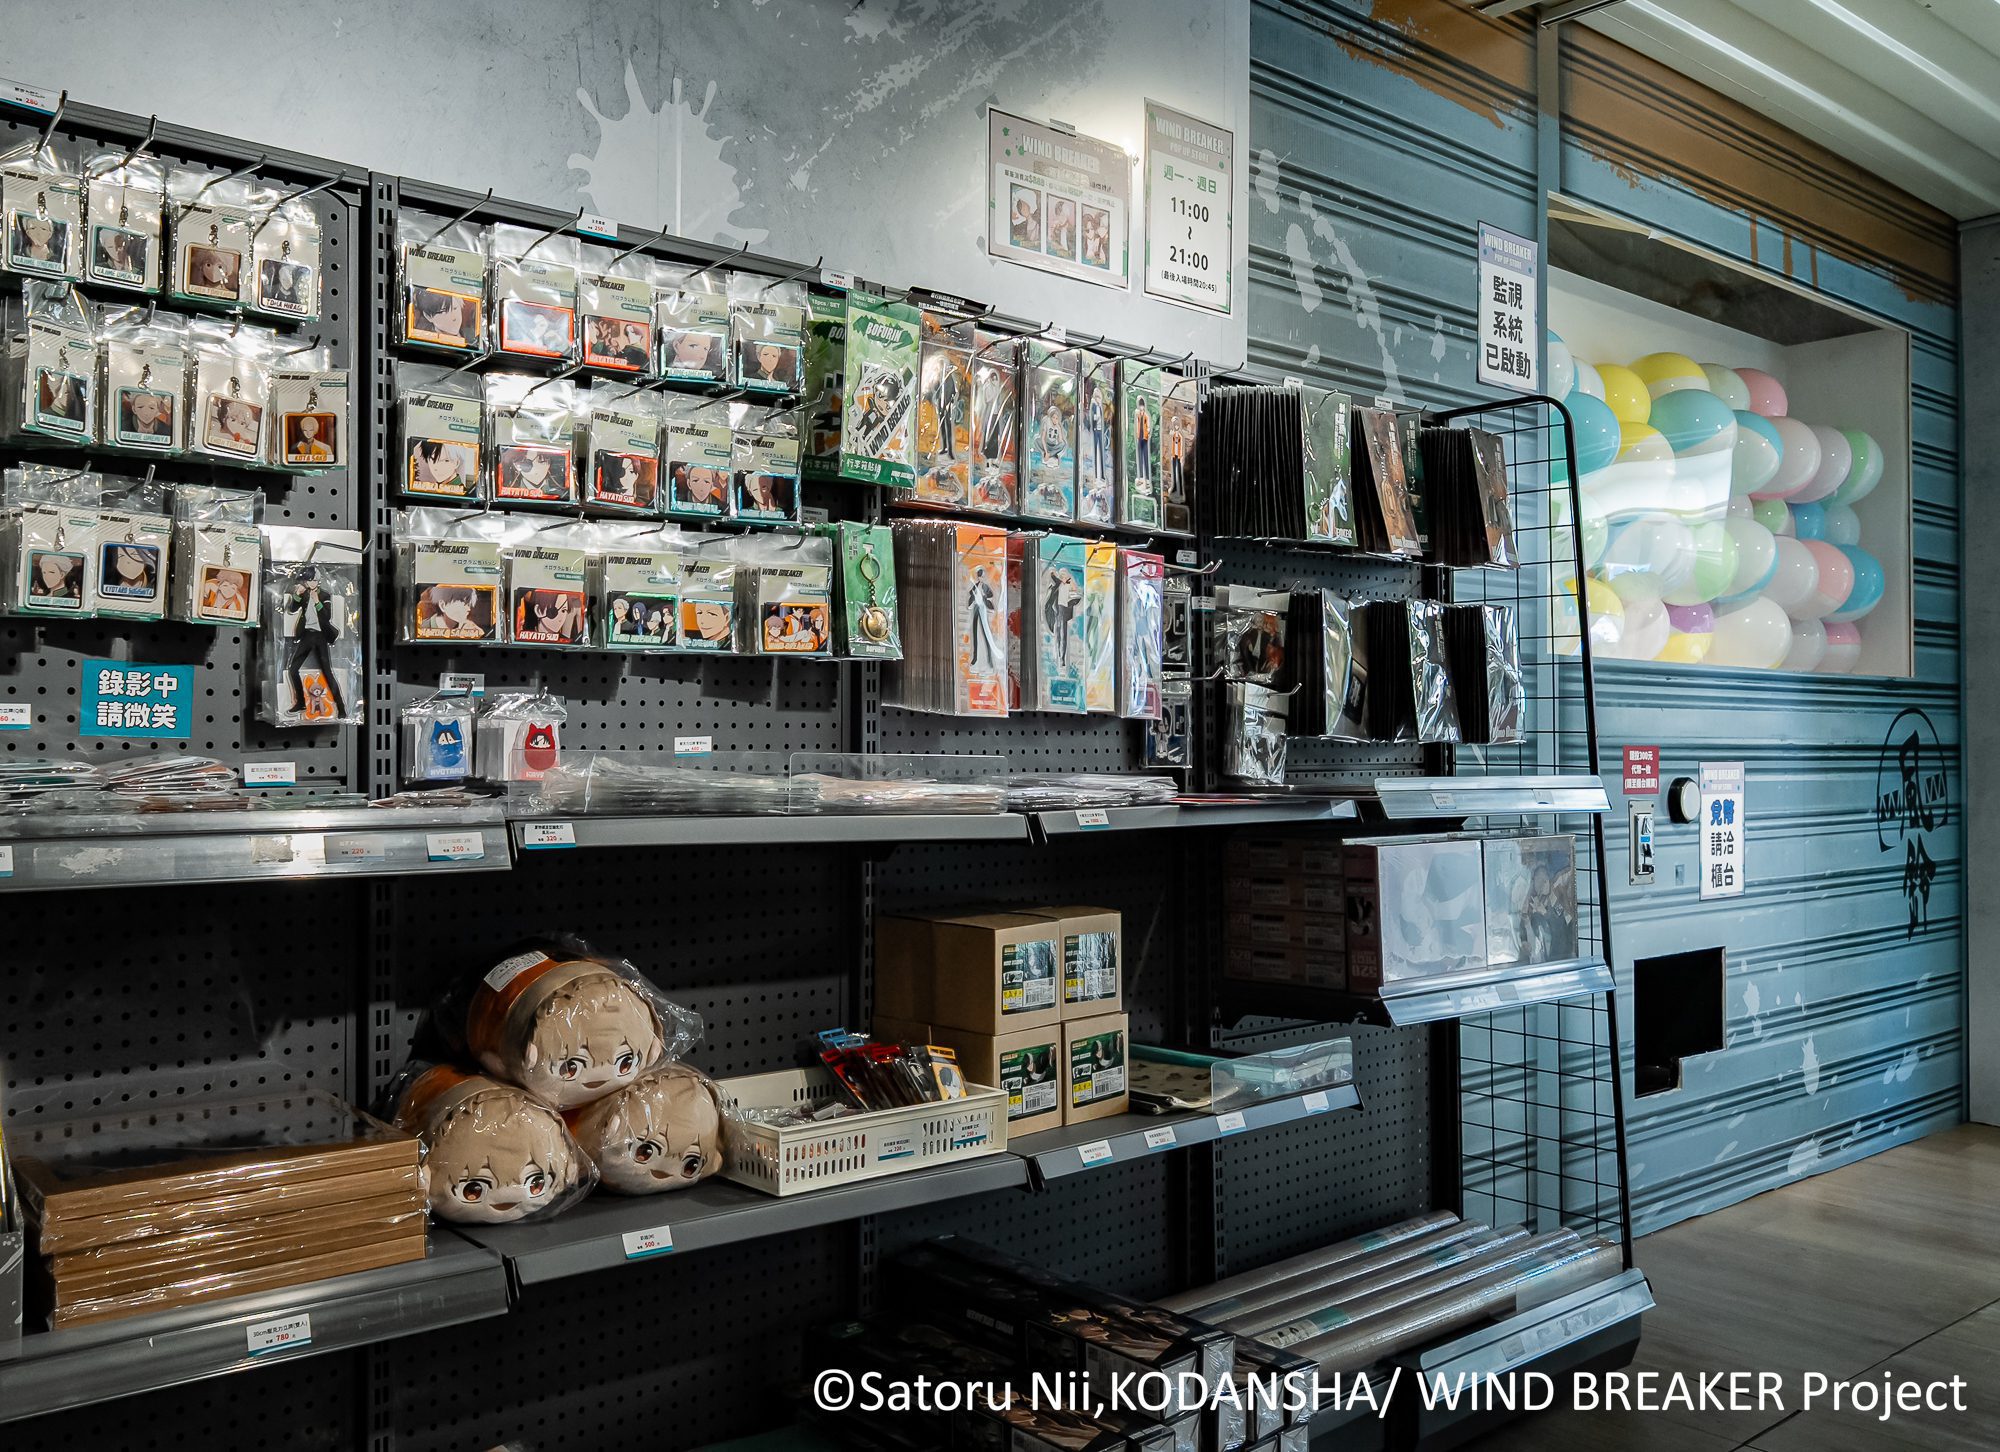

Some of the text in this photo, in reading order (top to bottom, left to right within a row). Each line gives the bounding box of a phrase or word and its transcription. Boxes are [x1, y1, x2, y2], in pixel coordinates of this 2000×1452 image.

[1155, 117, 1225, 154] WIND BREAKER
[1022, 134, 1052, 159] WIND
[1171, 196, 1209, 223] 11:00
[409, 247, 456, 264] WIND BREAKER
[1484, 232, 1532, 261] WIND BREAKER
[1170, 245, 1209, 271] 21:00
[600, 280, 626, 292] BREAKER
[1493, 275, 1523, 310] 監視
[866, 322, 902, 343] BOFURIN
[1493, 311, 1523, 344] 系統
[1486, 342, 1531, 380] 已啟動
[408, 396, 454, 411] WIND BREAKER
[594, 412, 633, 427] WIND BREAKER
[685, 428, 709, 438] BREAKER
[869, 428, 890, 455] WIND
[501, 486, 528, 496] HAYATO
[600, 490, 635, 503] HAYATO SUO
[417, 544, 469, 555] WIND BREAKER
[515, 549, 560, 561] WIND BREAKER
[608, 556, 652, 565] WIND BREAKER
[762, 568, 803, 577] WIND BREAKER
[519, 631, 559, 641] HAYATO SUO
[98, 669, 178, 699] 錄影中
[96, 701, 177, 729] 請微笑
[431, 767, 465, 776] KYOTARO
[1711, 830, 1735, 856] 請洽
[1711, 862, 1735, 888] 櫃台
[276, 1333, 289, 1341] 780
